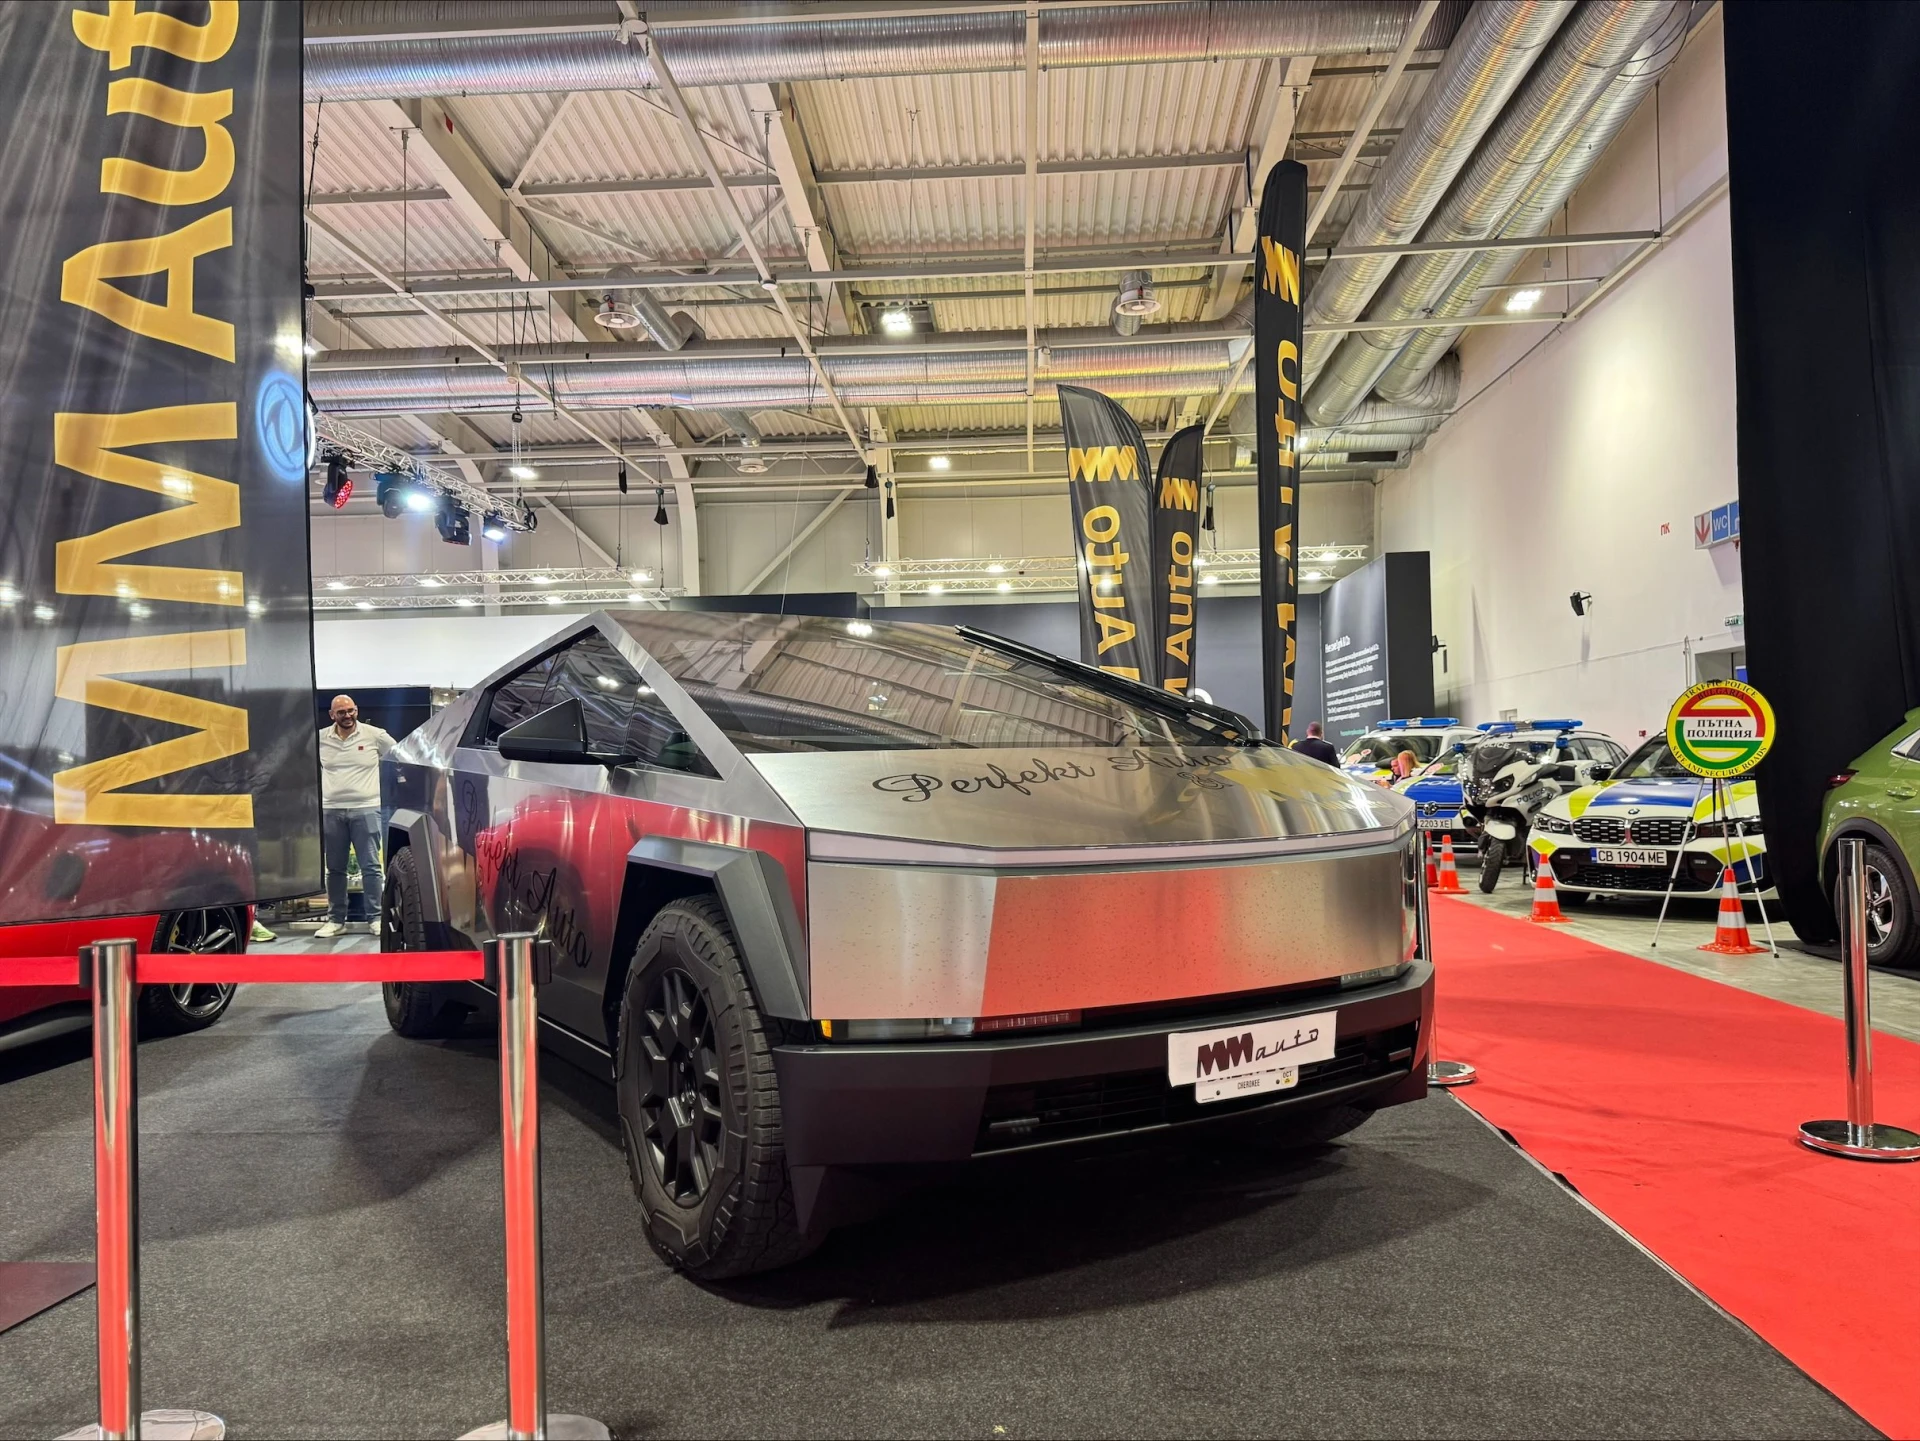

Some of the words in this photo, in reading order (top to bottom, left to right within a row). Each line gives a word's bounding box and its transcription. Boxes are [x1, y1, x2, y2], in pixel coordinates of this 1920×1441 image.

[1713, 515, 1728, 532] WC
[1166, 531, 1193, 665] Auto
[53, 402, 255, 829] MM
[1684, 681, 1722, 699] TRAFFIC
[1725, 680, 1758, 698] POLICE
[1697, 720, 1743, 728] ПЪТНА
[1687, 729, 1752, 739] ПОЛИЦИЯ
[1672, 745, 1687, 763] SAFE
[1686, 762, 1703, 774] AND
[1704, 766, 1741, 777] SECURE
[1741, 747, 1767, 771] ROADS
[872, 757, 1095, 802] Perfekt
[1420, 820, 1438, 828] 2203
[1598, 850, 1614, 862] CB
[1617, 851, 1645, 863] 1904
[1648, 852, 1665, 863] ME
[1197, 1032, 1254, 1078] MM
[1255, 1028, 1319, 1061] auto
[1237, 1079, 1260, 1089] CHEROKEE
